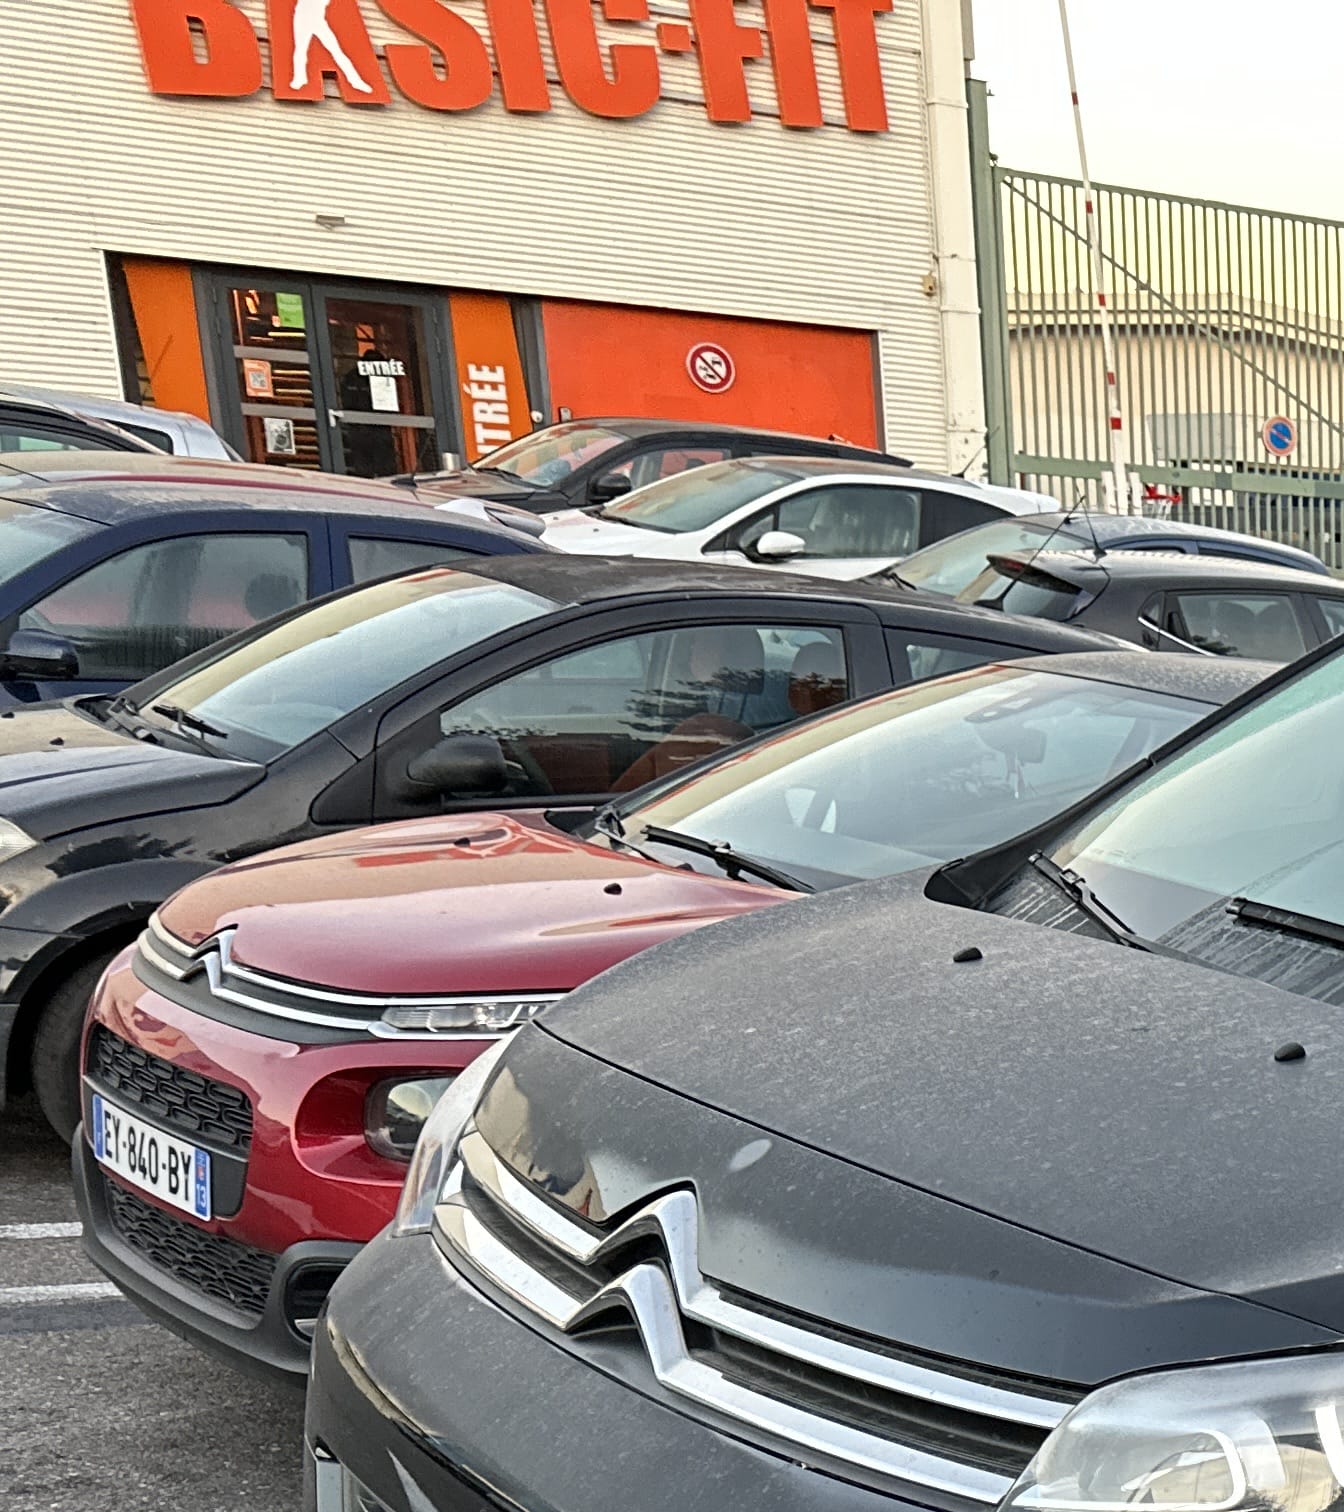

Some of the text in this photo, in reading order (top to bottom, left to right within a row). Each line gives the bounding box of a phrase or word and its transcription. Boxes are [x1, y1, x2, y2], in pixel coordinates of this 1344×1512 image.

[131, 0, 893, 132] BASIC-FIT
[356, 358, 406, 377] ENTRÉE
[463, 363, 513, 458] TRÉE
[104, 1109, 192, 1202] EY-840-BY
